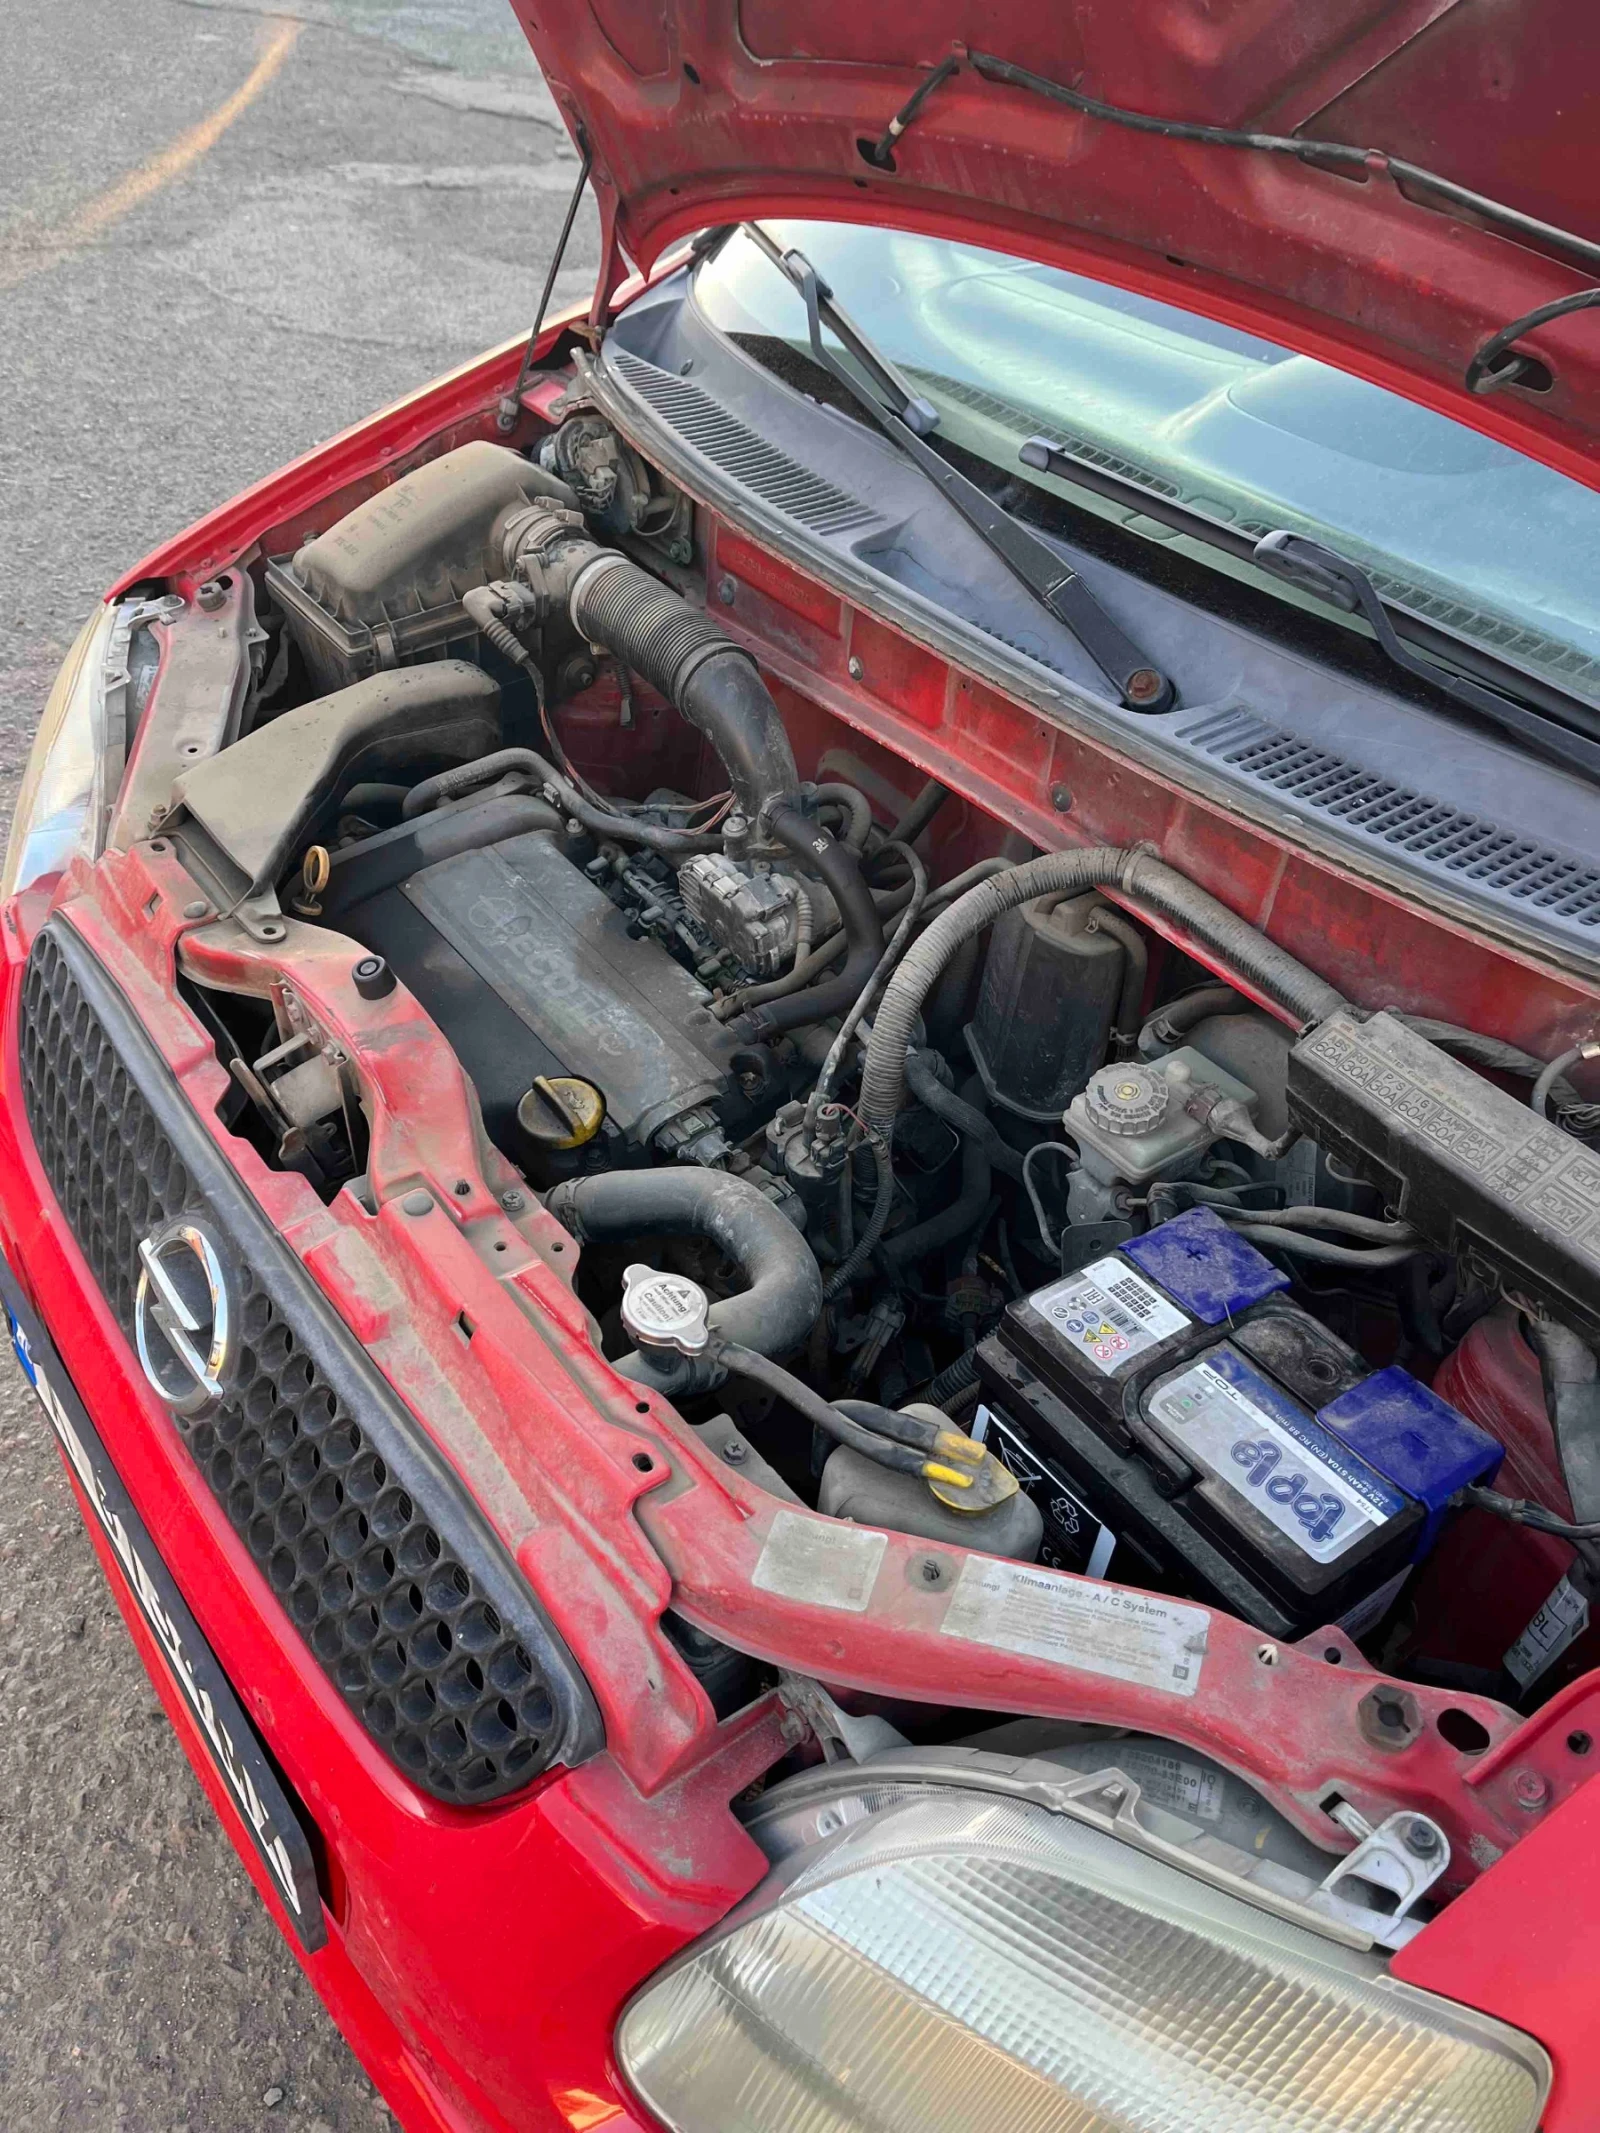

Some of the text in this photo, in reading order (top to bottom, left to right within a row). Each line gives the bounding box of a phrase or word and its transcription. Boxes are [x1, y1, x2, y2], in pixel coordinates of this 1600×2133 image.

[1314, 1040, 1341, 1063] 60A
[1327, 1034, 1350, 1052] ABS
[1341, 1059, 1368, 1083] 30A
[1383, 1072, 1406, 1092] P/S
[1368, 1078, 1396, 1103] 30A
[1397, 1099, 1425, 1124] 60A
[1437, 1111, 1467, 1134] LAMP
[1426, 1119, 1455, 1145] 60A
[1468, 1132, 1497, 1155] BATT
[1568, 1165, 1600, 1194] RELA
[643, 1292, 673, 1321] Caution!
[658, 1284, 690, 1314] Achtung!
[1083, 1288, 1104, 1304] EAC
[1202, 1370, 1239, 1401] TOP
[1288, 1425, 1300, 1435] 88
[1298, 1433, 1311, 1445] RC
[1309, 1443, 1328, 1459] (EN)
[1327, 1458, 1348, 1476] 510A
[1231, 1440, 1351, 1543] topla
[1346, 1475, 1368, 1493] 54Ah
[1355, 1498, 1374, 1514] TT54
[1366, 1492, 1383, 1506] 12V
[1013, 1573, 1083, 1599] Klimaanlage
[1092, 1593, 1101, 1603] A
[1111, 1597, 1120, 1607] C
[1123, 1601, 1168, 1619] System
[1532, 1611, 1549, 1638] BL
